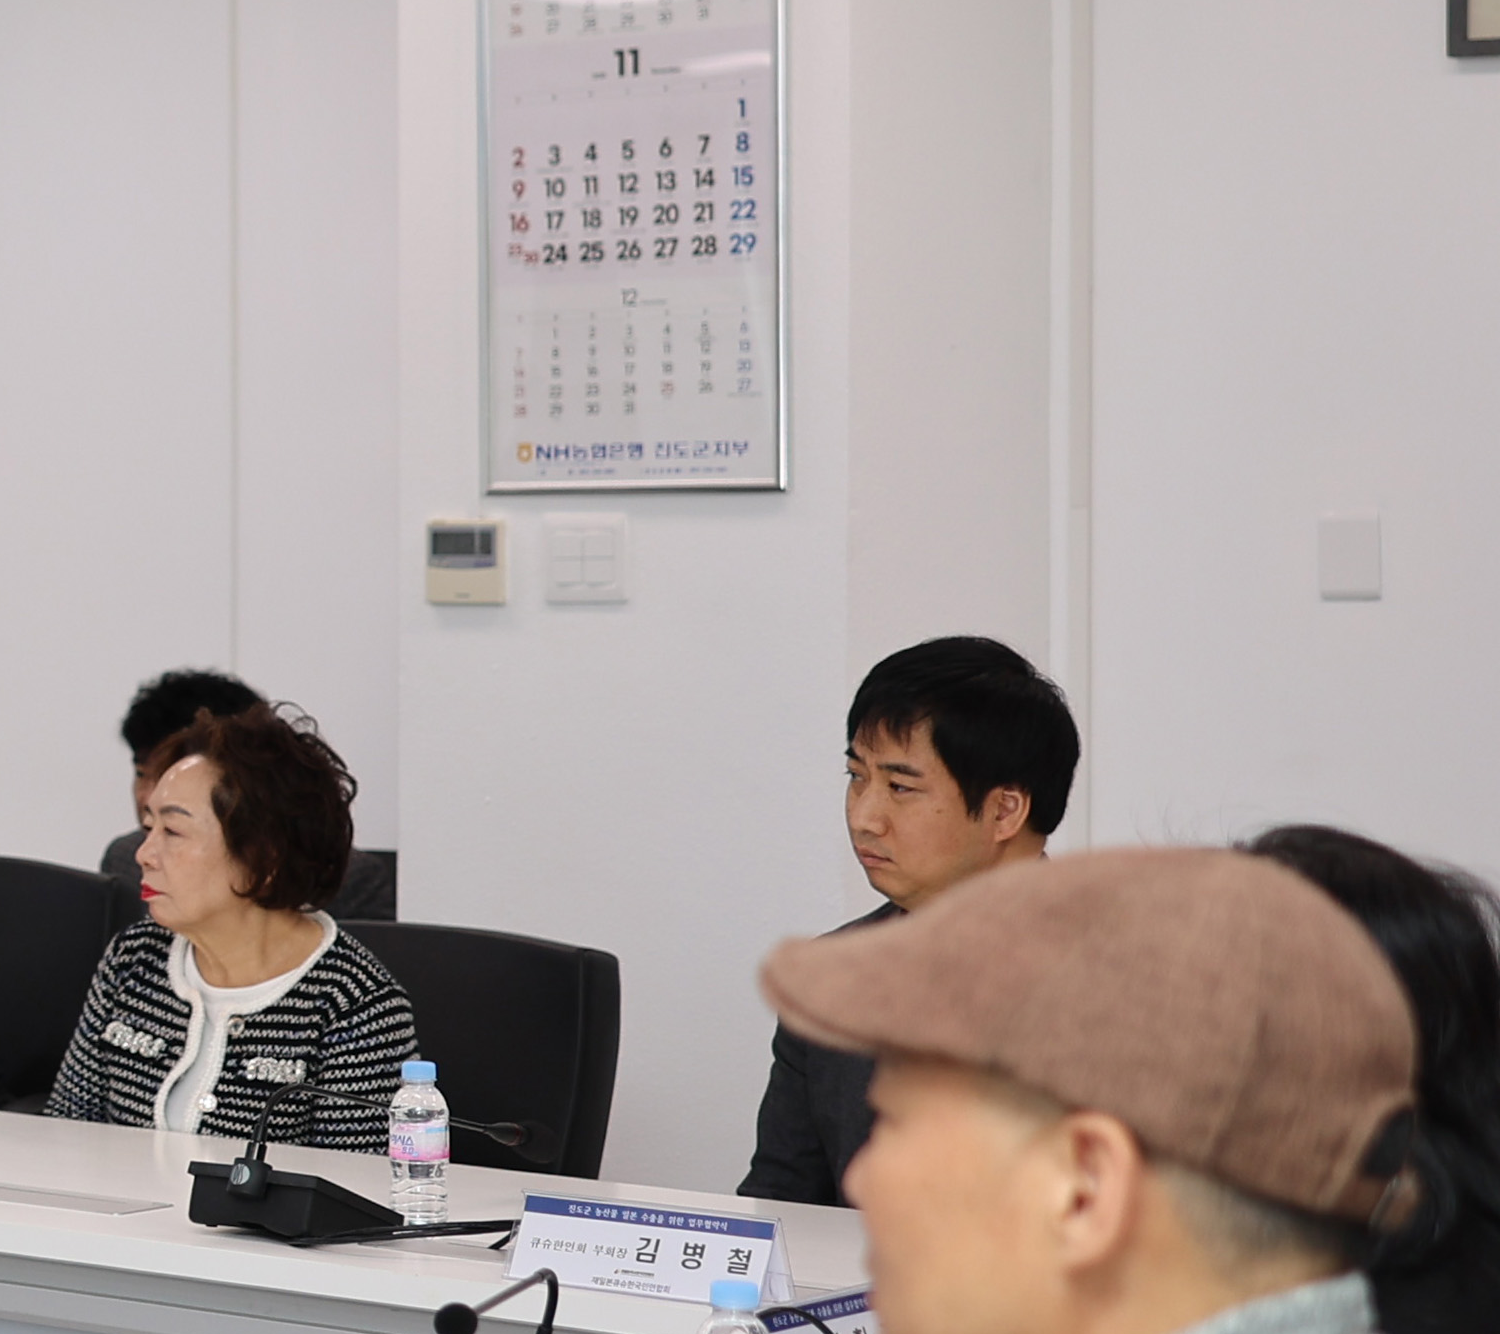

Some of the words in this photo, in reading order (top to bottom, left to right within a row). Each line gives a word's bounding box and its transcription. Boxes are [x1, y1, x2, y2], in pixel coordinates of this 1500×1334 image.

[614, 49, 641, 77] 11
[737, 99, 746, 117] 1
[512, 148, 525, 168] 2
[548, 145, 561, 165] 3
[584, 144, 597, 162] 4
[621, 140, 634, 159] 5
[659, 138, 673, 158] 6
[697, 135, 710, 155] 7
[735, 132, 749, 152] 8
[512, 181, 525, 201] 9
[545, 179, 565, 197] 10
[583, 177, 598, 195] 11
[618, 174, 638, 193] 12
[656, 172, 676, 190] 13
[693, 169, 715, 187] 14
[732, 167, 754, 186] 15
[510, 213, 530, 233] 16
[546, 212, 564, 230] 17
[582, 210, 602, 228] 18
[619, 207, 638, 226] 19
[653, 205, 679, 224] 20
[693, 203, 714, 221] 21
[730, 200, 756, 220] 22
[543, 245, 568, 264] 24
[579, 243, 604, 263] 25
[616, 242, 641, 260] 26
[653, 239, 679, 257] 27
[691, 236, 717, 256] 28
[729, 234, 756, 254] 29
[536, 442, 643, 460] NH농협은행
[568, 1205, 592, 1217] 진도군
[595, 1207, 618, 1219] 농산물
[622, 1210, 637, 1221] 일본
[640, 1212, 665, 1224] 수출을
[668, 1215, 684, 1226] 위한
[688, 1218, 728, 1231] 업무협약식
[530, 1237, 586, 1253] 큐슈한인회
[592, 1245, 628, 1258] 부회장
[635, 1237, 752, 1275] 김병철
